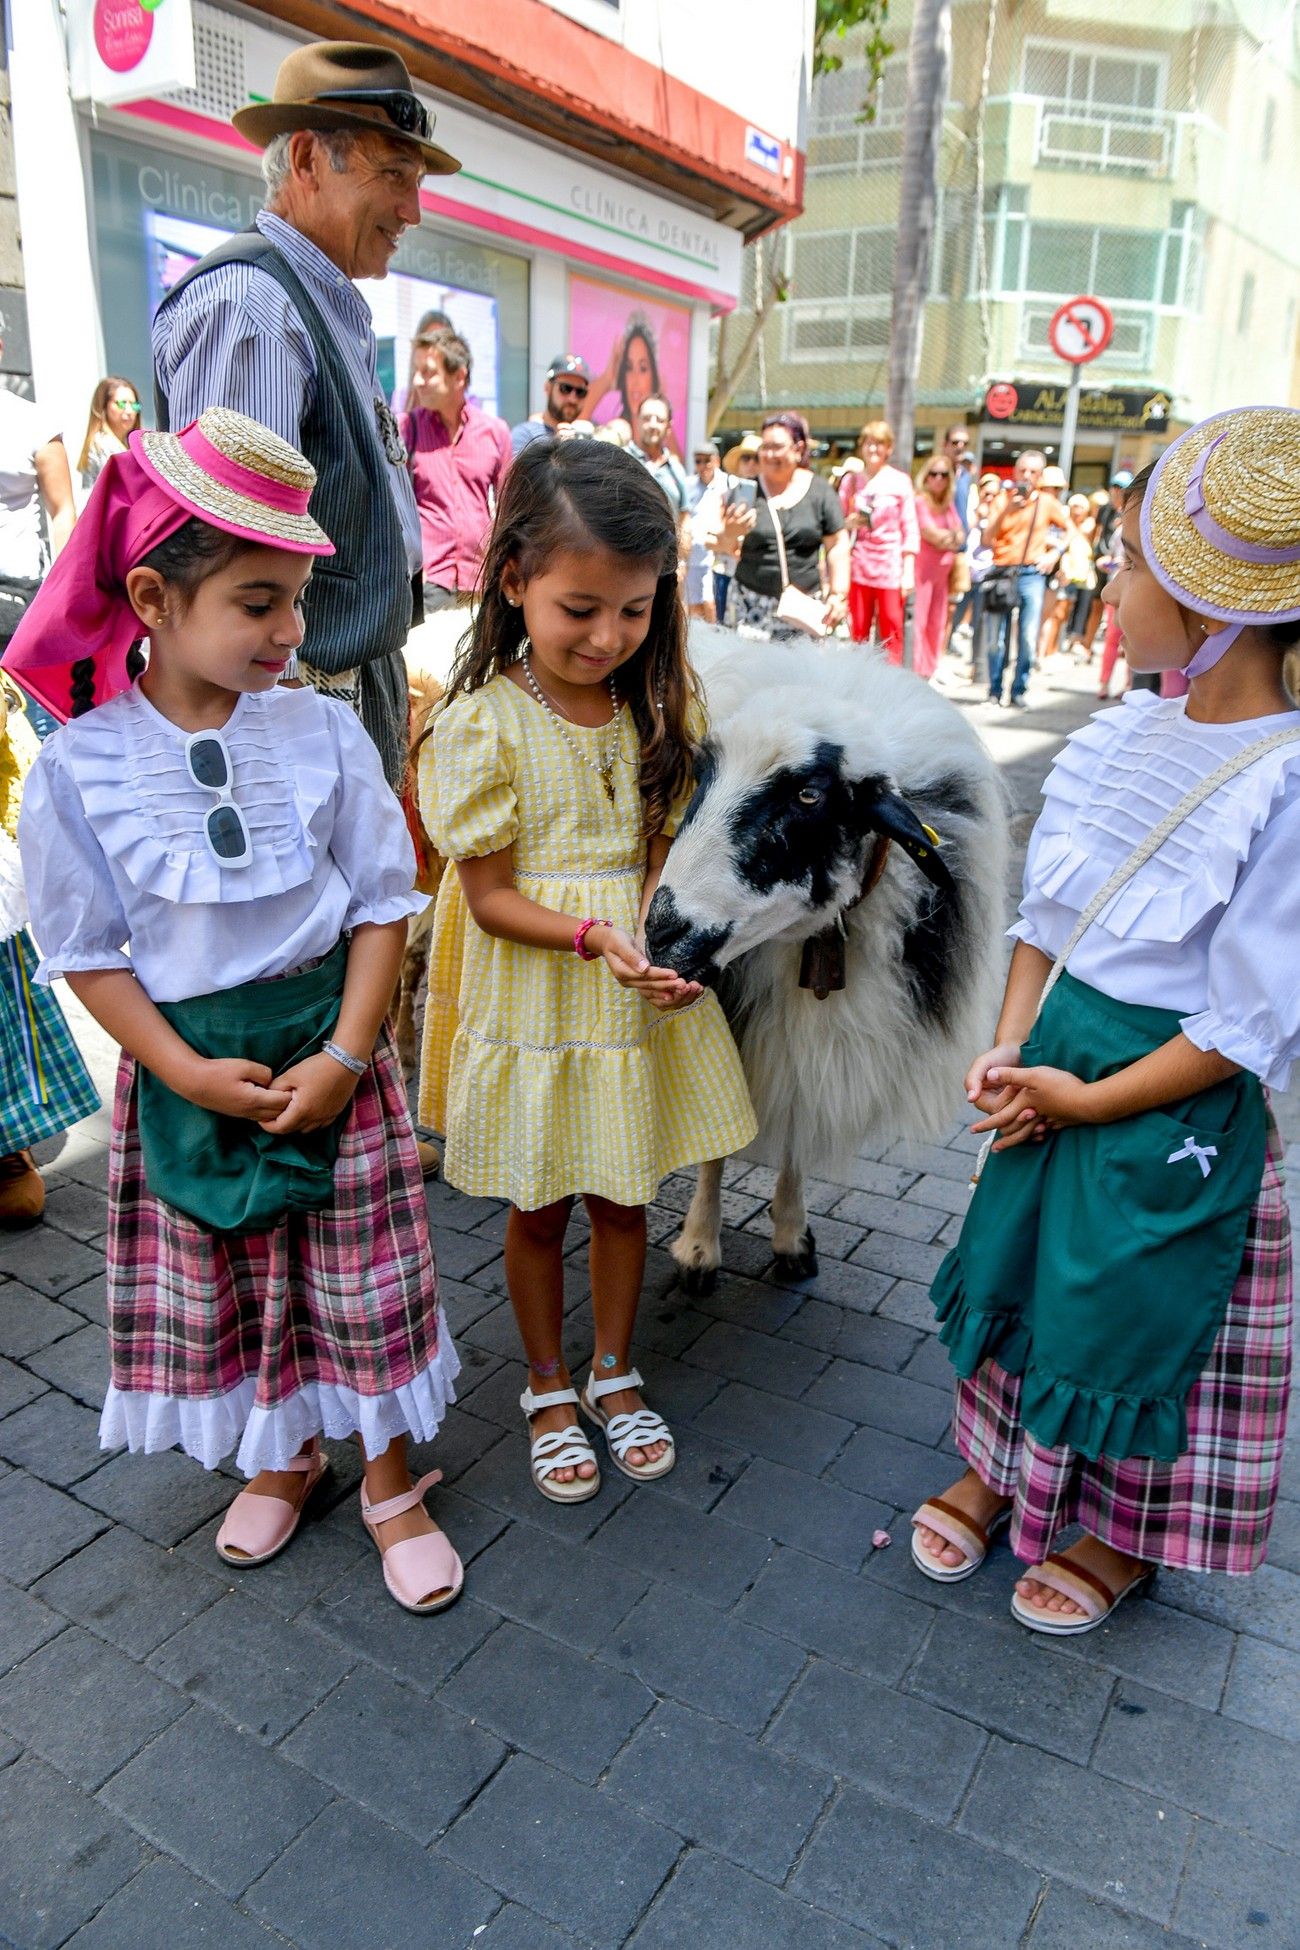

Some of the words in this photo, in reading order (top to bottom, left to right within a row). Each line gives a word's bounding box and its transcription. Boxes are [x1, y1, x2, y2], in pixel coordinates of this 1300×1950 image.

[138, 166, 242, 225] Clínica
[571, 186, 649, 234] CLÍNICA
[658, 220, 719, 261] DENTAL
